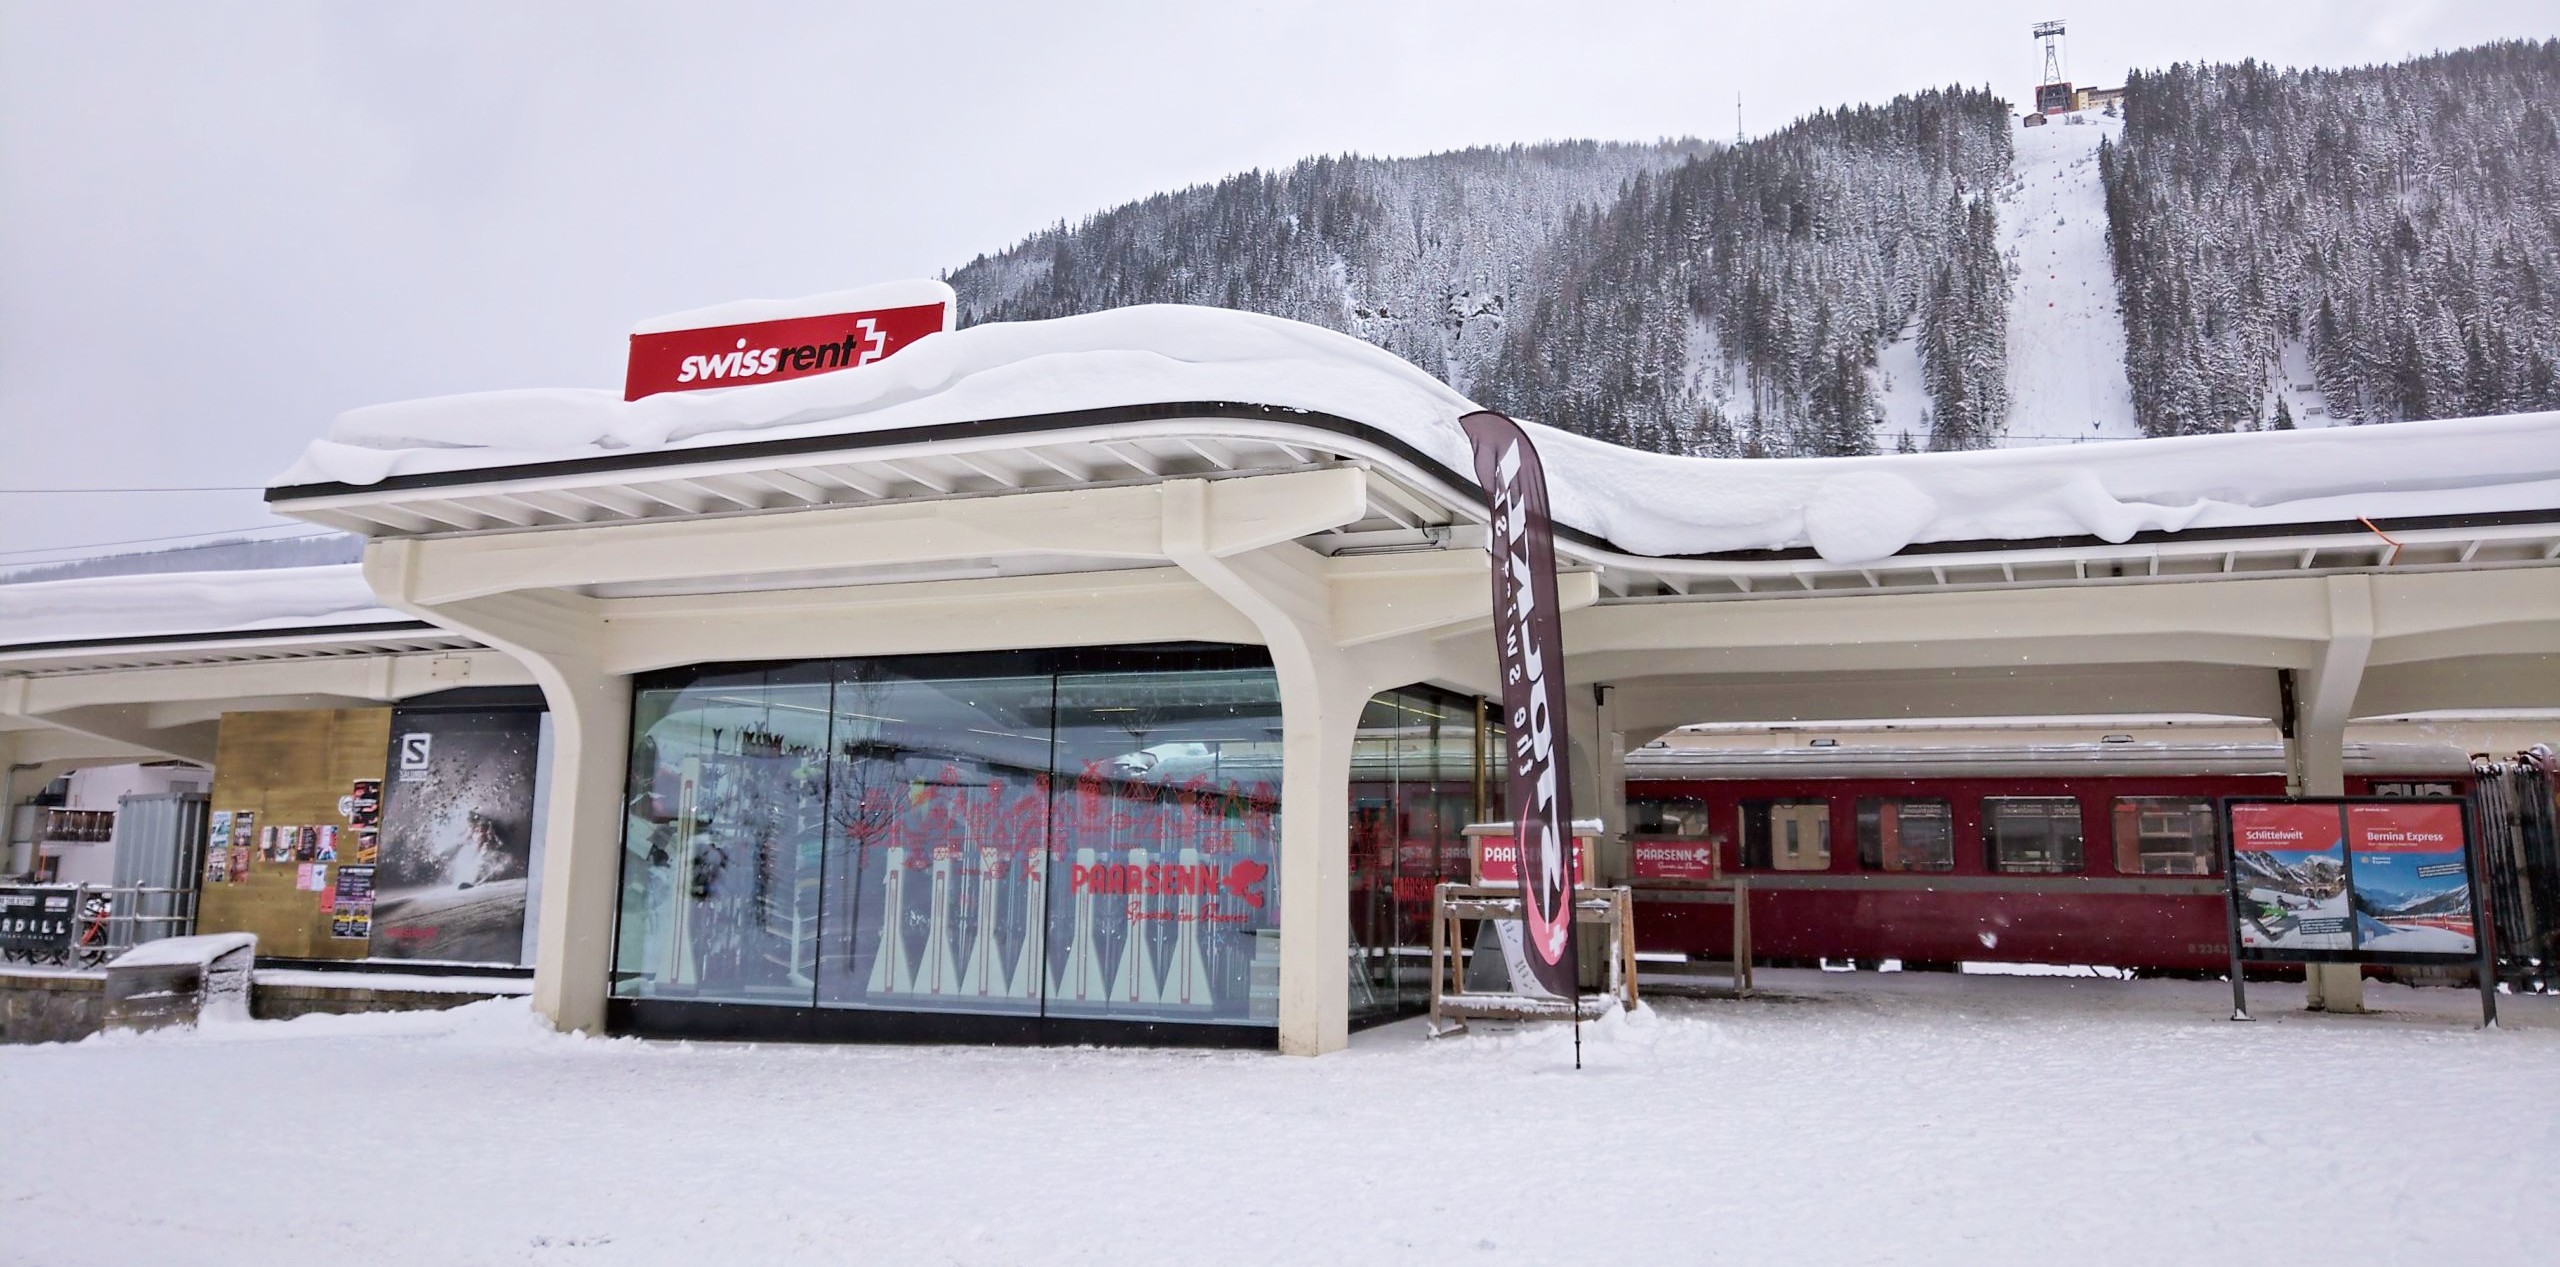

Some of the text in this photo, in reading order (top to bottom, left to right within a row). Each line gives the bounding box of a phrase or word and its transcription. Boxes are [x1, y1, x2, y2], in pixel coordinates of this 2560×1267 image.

[677, 334, 857, 383] swissrent
[2245, 831, 2304, 840] Schlittelwelt
[2367, 831, 2444, 843] Bernina Express
[1636, 849, 1693, 861] PAARSENN
[1071, 863, 1220, 896] PAARSENN
